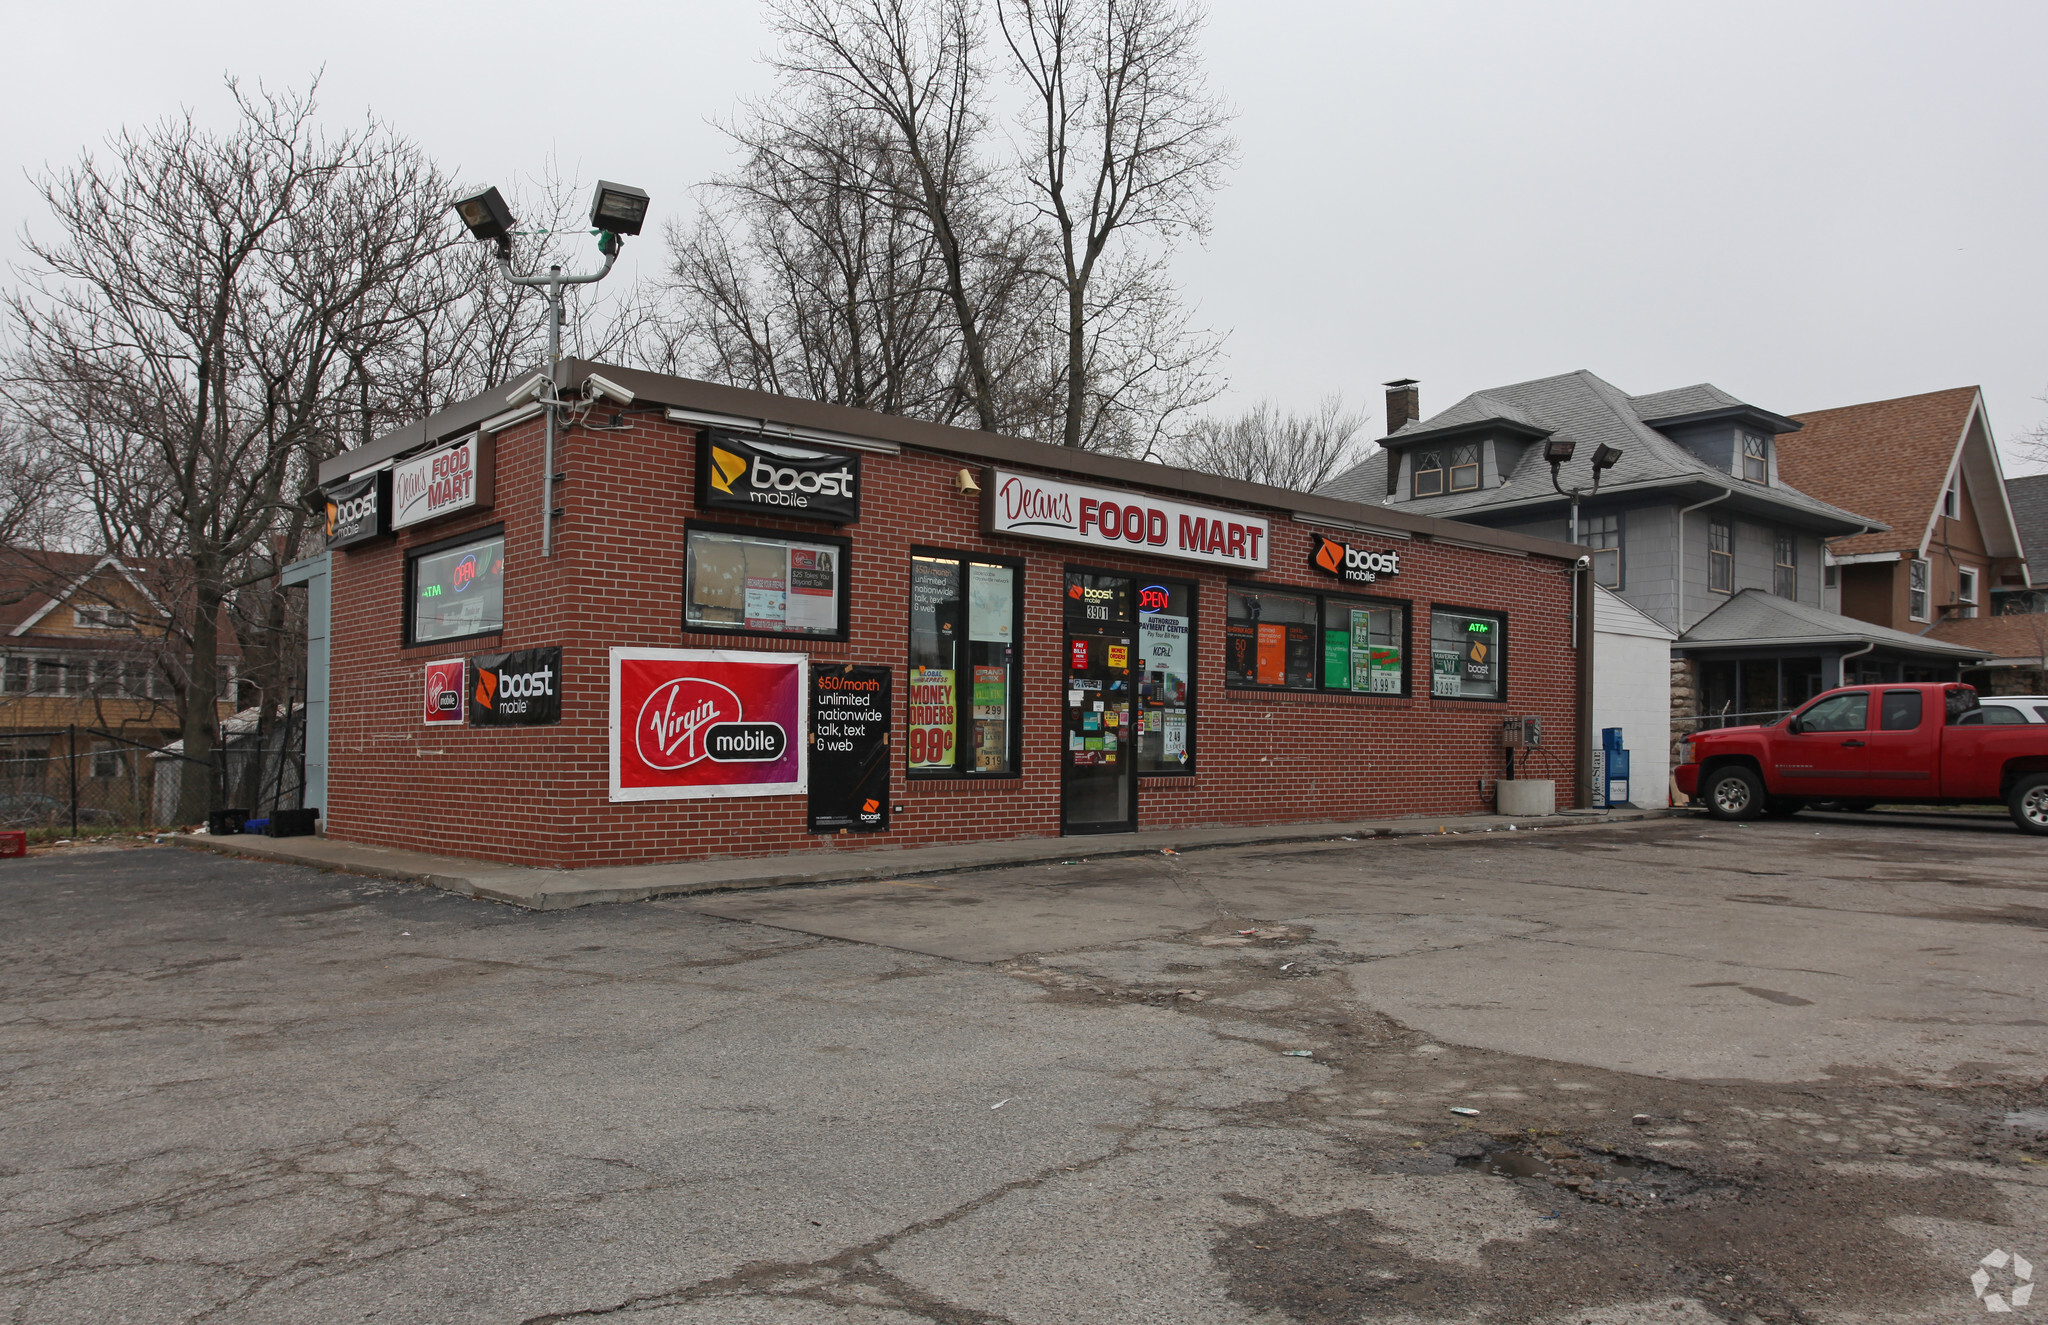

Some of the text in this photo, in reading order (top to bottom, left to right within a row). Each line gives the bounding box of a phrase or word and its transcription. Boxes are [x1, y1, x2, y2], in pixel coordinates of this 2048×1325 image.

[432, 446, 470, 483] FOOD
[750, 456, 853, 498] boost
[397, 465, 426, 509] Dean's
[428, 470, 472, 511] MART
[337, 486, 377, 525] boost
[750, 491, 807, 508] mobile
[1000, 477, 1264, 560] Dean's FOOD MART
[337, 523, 359, 539] mobile
[1345, 544, 1400, 574] boost
[454, 561, 475, 586] OPEN
[804, 571, 819, 580] Takes
[820, 572, 830, 580] You
[915, 576, 947, 586] unlimited
[1345, 570, 1375, 583] mobile
[792, 578, 812, 586] Beyond
[914, 586, 954, 597] nationwide
[1084, 586, 1114, 600] boost
[914, 594, 944, 605] talk, text
[914, 603, 936, 613] & web
[1087, 605, 1108, 620] 3901
[1139, 622, 1189, 634] PAYMENT CENTER
[1148, 617, 1179, 626] AUTHORIZED
[1467, 663, 1489, 674] boost
[499, 665, 553, 698] boost
[818, 676, 880, 691] $50/month
[440, 696, 455, 705] mobile
[818, 692, 870, 706] unlimited
[910, 685, 952, 704] MONEY
[499, 699, 527, 714] mobile
[650, 684, 721, 757] Virgin
[817, 708, 882, 721] nationwide
[909, 705, 954, 725] ORDERS
[817, 723, 866, 737] talk, text
[716, 730, 775, 751] mobile
[817, 738, 853, 751] & web
[910, 728, 953, 764] 99¢
[1592, 751, 1601, 777] Star
